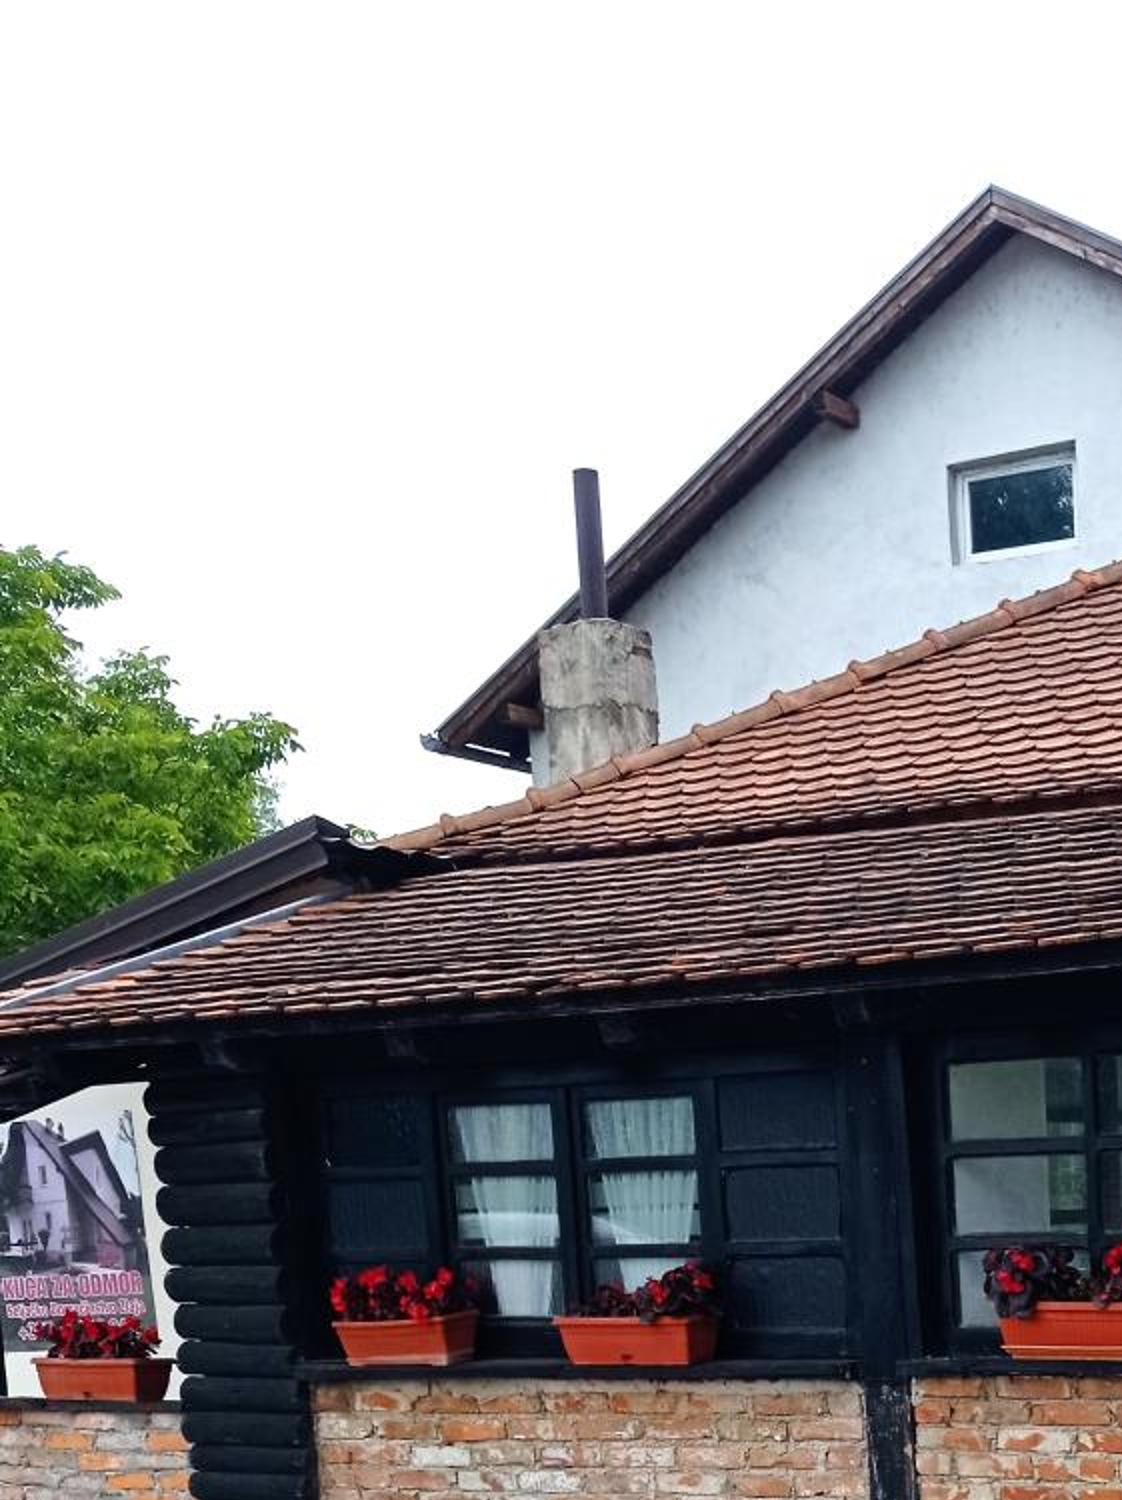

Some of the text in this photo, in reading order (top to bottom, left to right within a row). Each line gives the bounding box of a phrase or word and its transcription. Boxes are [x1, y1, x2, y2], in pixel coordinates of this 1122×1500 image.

[2, 1269, 144, 1300] KUĆA ZA ODMOR
